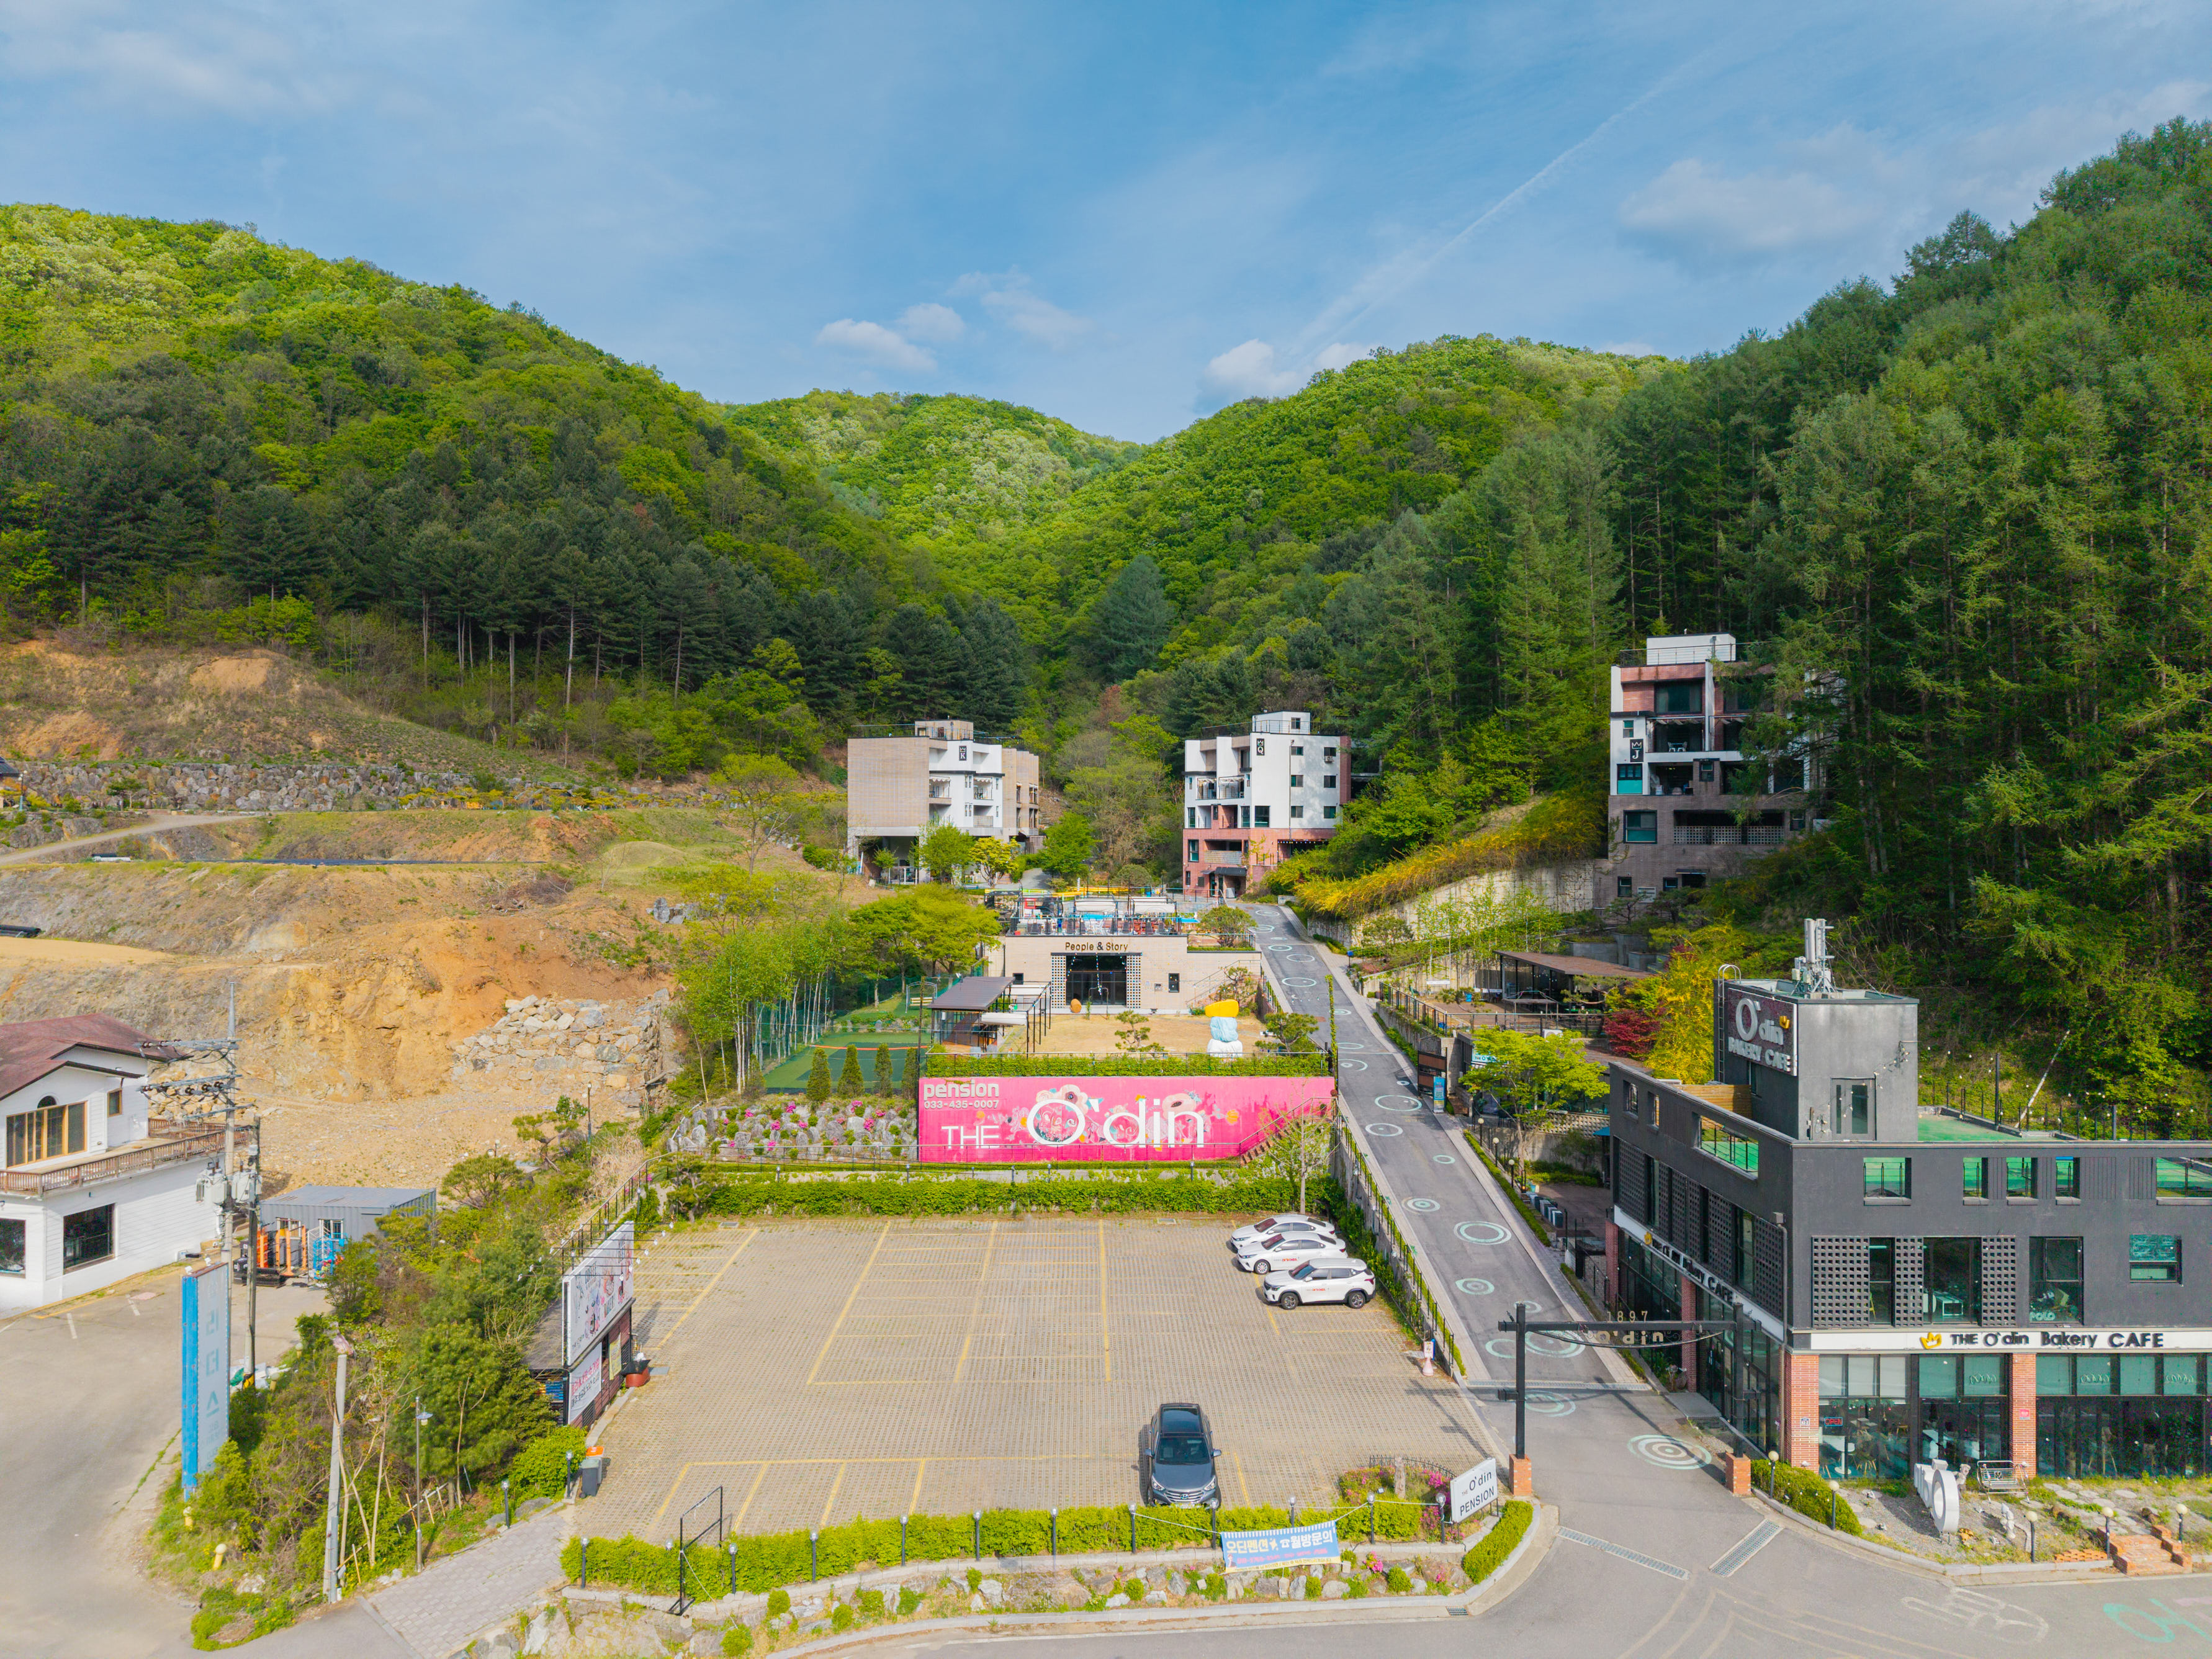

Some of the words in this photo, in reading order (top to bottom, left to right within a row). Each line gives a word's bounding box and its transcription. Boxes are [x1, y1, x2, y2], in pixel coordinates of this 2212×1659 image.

[1257, 747, 1264, 755] Q
[1632, 750, 1639, 759] J
[1065, 942, 1094, 951] People
[1097, 942, 1104, 950] &
[1106, 942, 1128, 951] Story
[1729, 1036, 1762, 1061] BAKERY
[1765, 1049, 1791, 1072] CAFE
[924, 1079, 999, 1101] pension
[924, 1100, 999, 1109] 033-435-0007
[942, 1125, 999, 1149] THE
[1607, 1311, 1648, 1323] 1897
[1950, 1333, 1979, 1346] THE
[2040, 1331, 2098, 1348] Bakery
[2108, 1332, 2164, 1348] CAFE
[1460, 1486, 1494, 1516] PENSION
